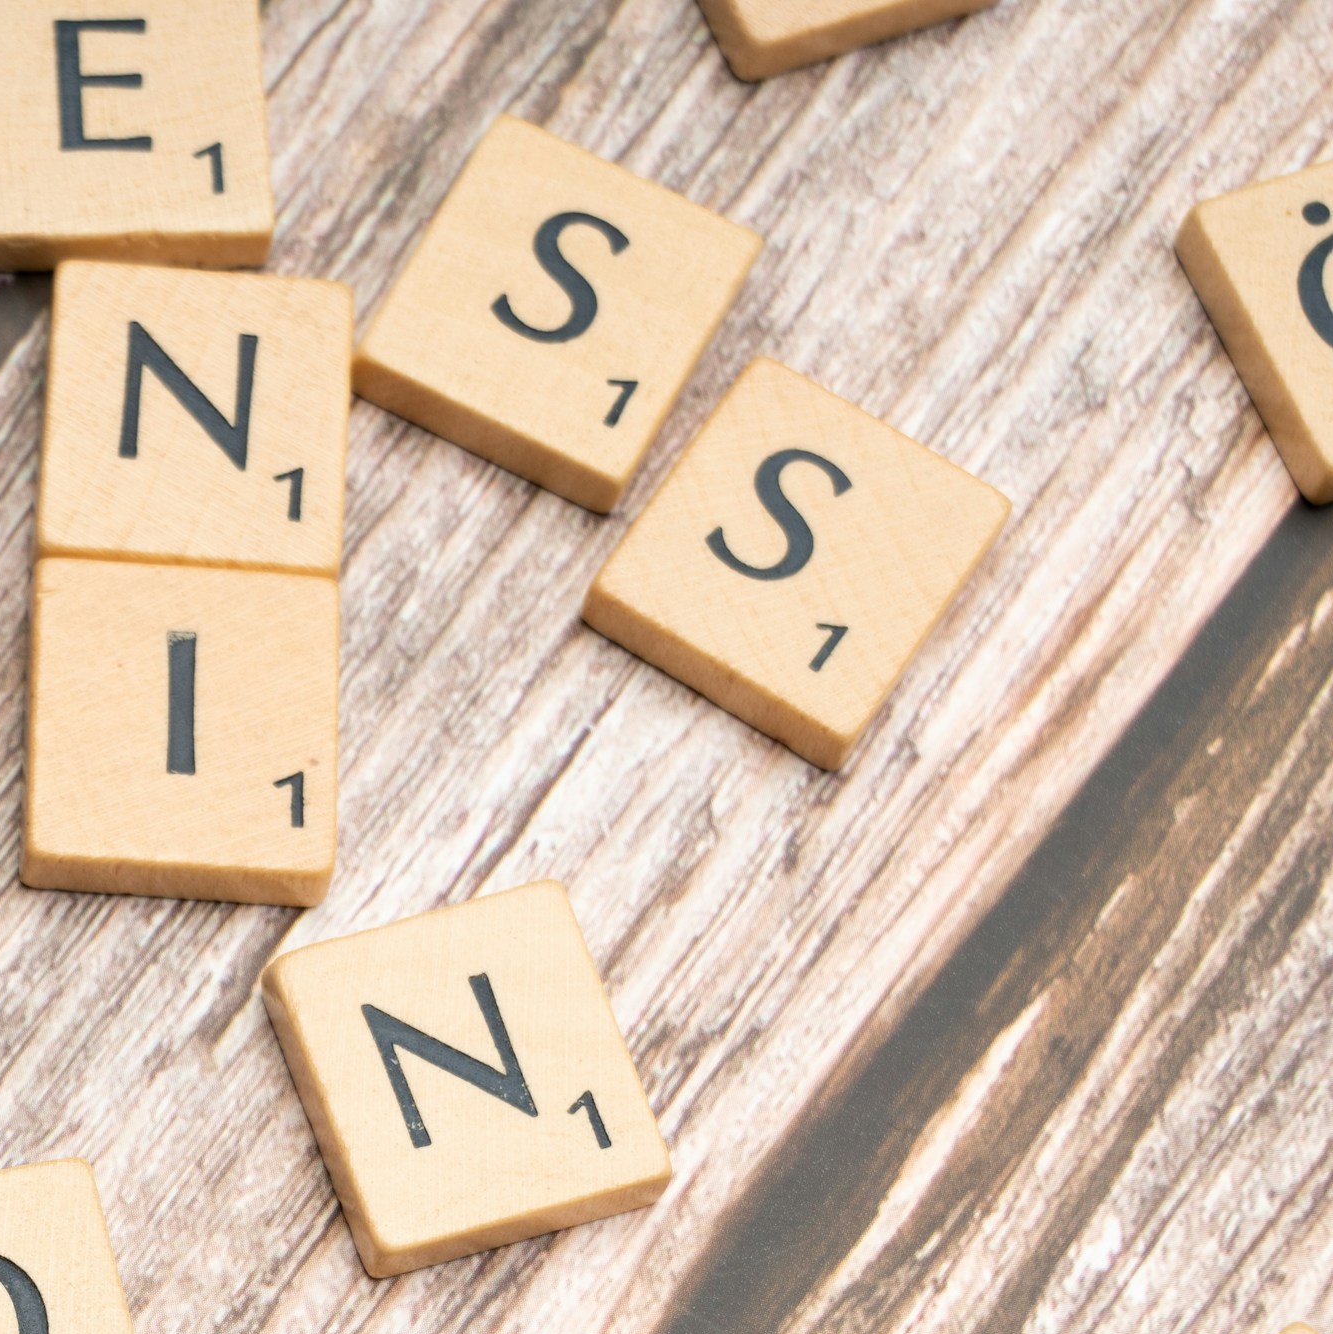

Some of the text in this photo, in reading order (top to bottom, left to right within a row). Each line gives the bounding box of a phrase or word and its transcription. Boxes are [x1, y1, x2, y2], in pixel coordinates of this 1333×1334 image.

[53, 18, 224, 194] E 1
[491, 211, 639, 428] S 1
[118, 321, 304, 522] N 1
[705, 448, 852, 672] S 1
[273, 771, 305, 828] 1
[361, 973, 612, 1149] N 1
